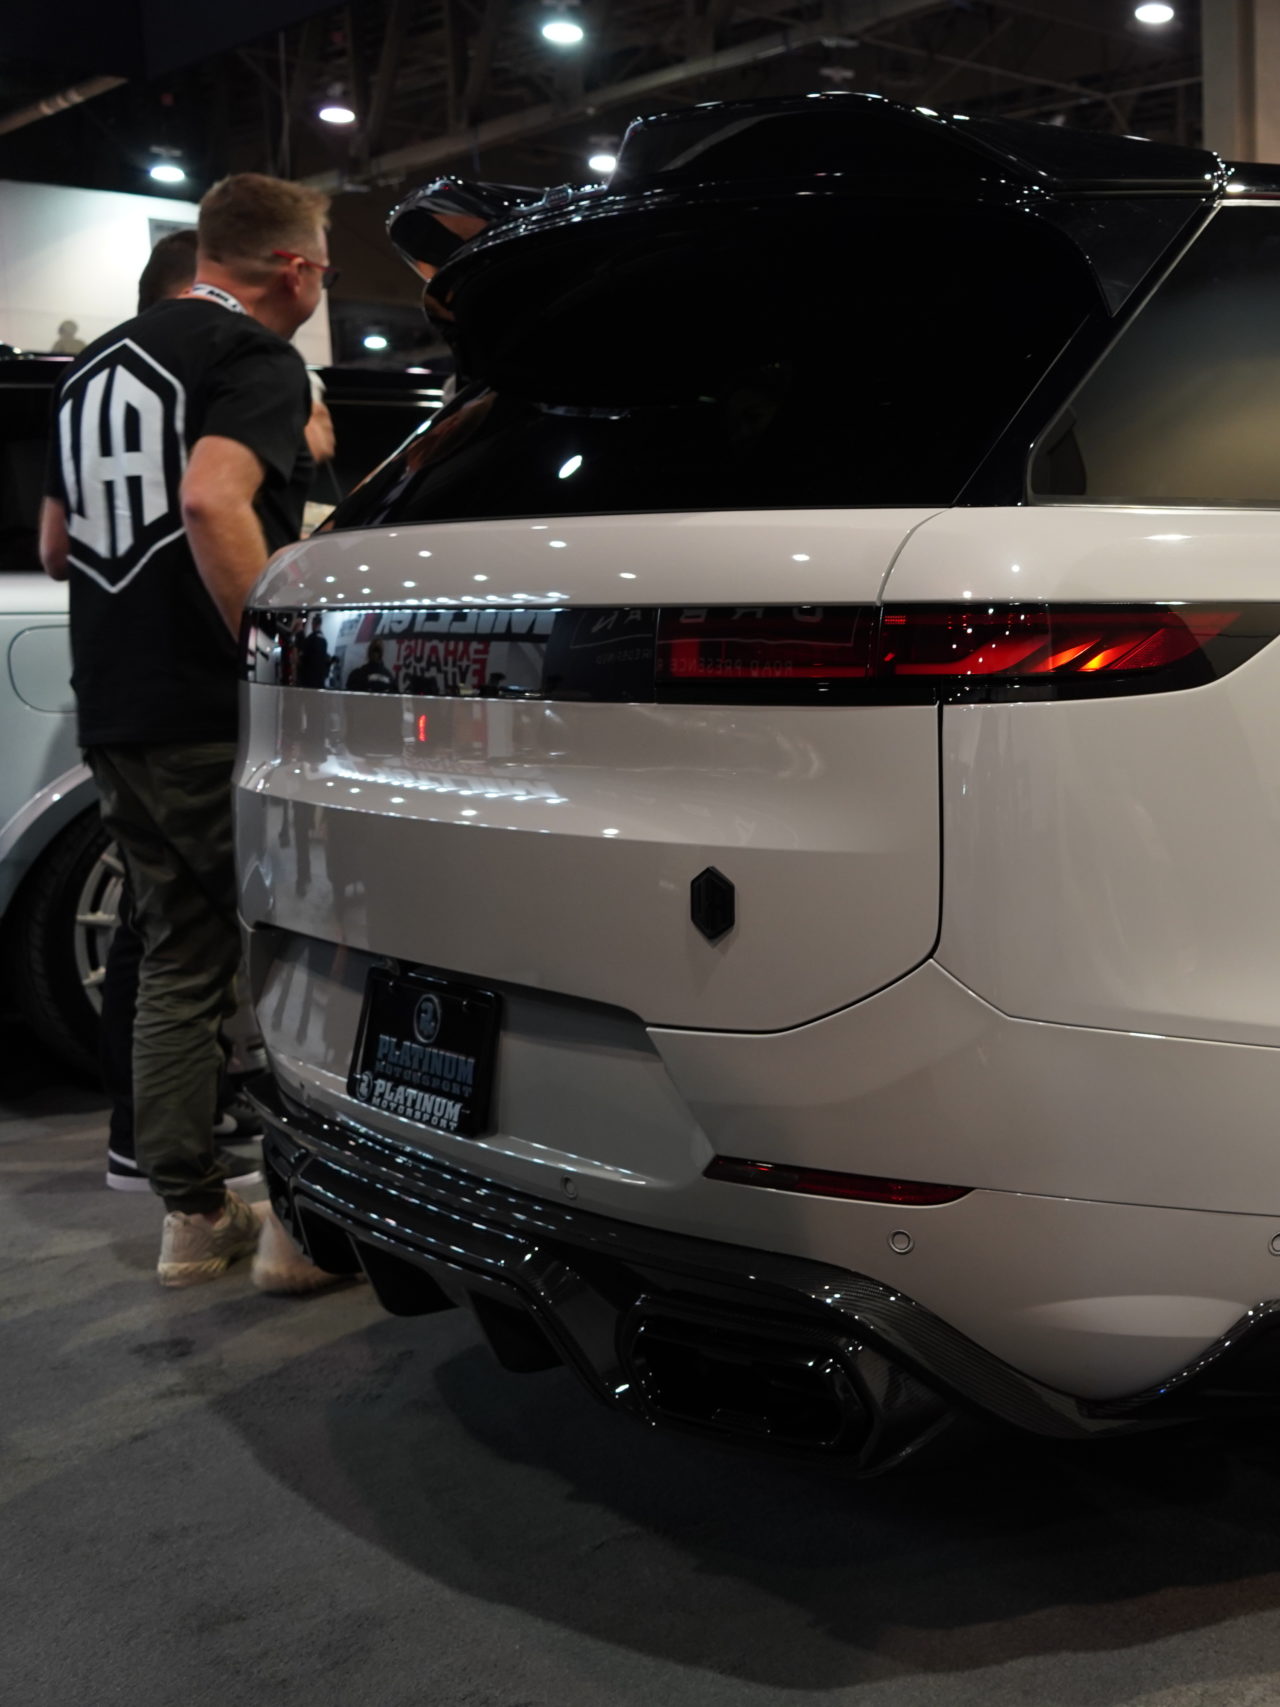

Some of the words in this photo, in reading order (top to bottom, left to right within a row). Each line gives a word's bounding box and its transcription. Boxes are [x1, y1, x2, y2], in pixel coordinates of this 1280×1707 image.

[374, 1060, 473, 1098] MOTORSPORT
[376, 1034, 476, 1085] PLATINUM
[371, 1096, 459, 1132] MOTORSPORT
[374, 1079, 463, 1122] PLATINUM
